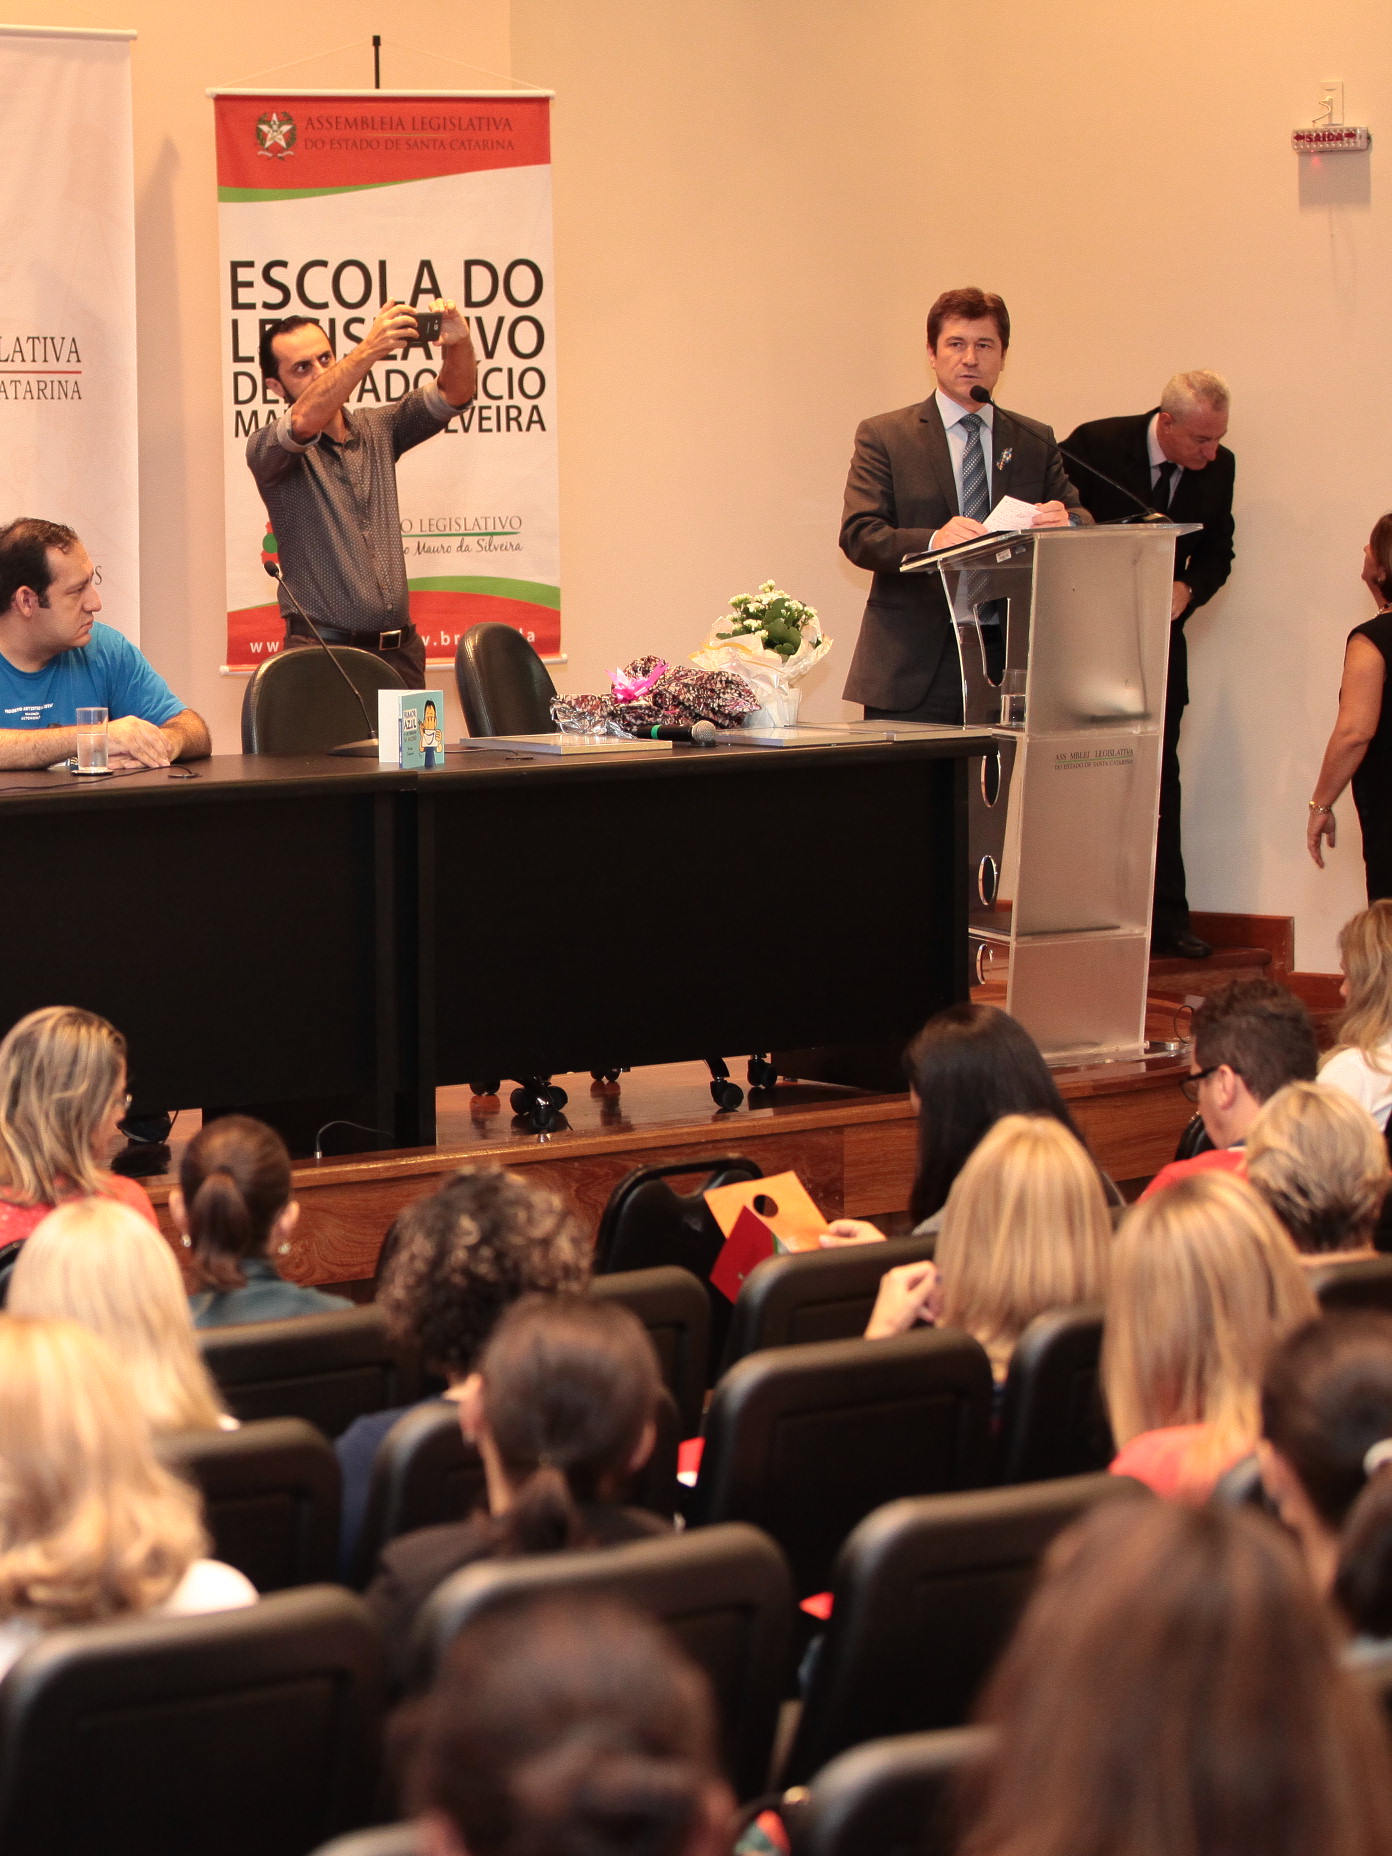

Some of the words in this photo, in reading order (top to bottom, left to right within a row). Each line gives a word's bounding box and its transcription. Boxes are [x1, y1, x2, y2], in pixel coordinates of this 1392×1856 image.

[305, 115, 405, 131] ASSEMBLEIA
[411, 115, 514, 132] LEGISLATIVA
[304, 138, 325, 150] DO
[329, 138, 380, 151] ESTADO
[384, 138, 400, 150] DE
[405, 138, 446, 151] SANTA
[449, 138, 515, 151] CATARINA
[230, 258, 443, 311] ESCOLA
[463, 258, 544, 309] DO
[419, 515, 522, 532] LEGISLATIVO
[413, 540, 452, 556] Mauro
[456, 537, 473, 553] da
[475, 535, 524, 553] Silveira
